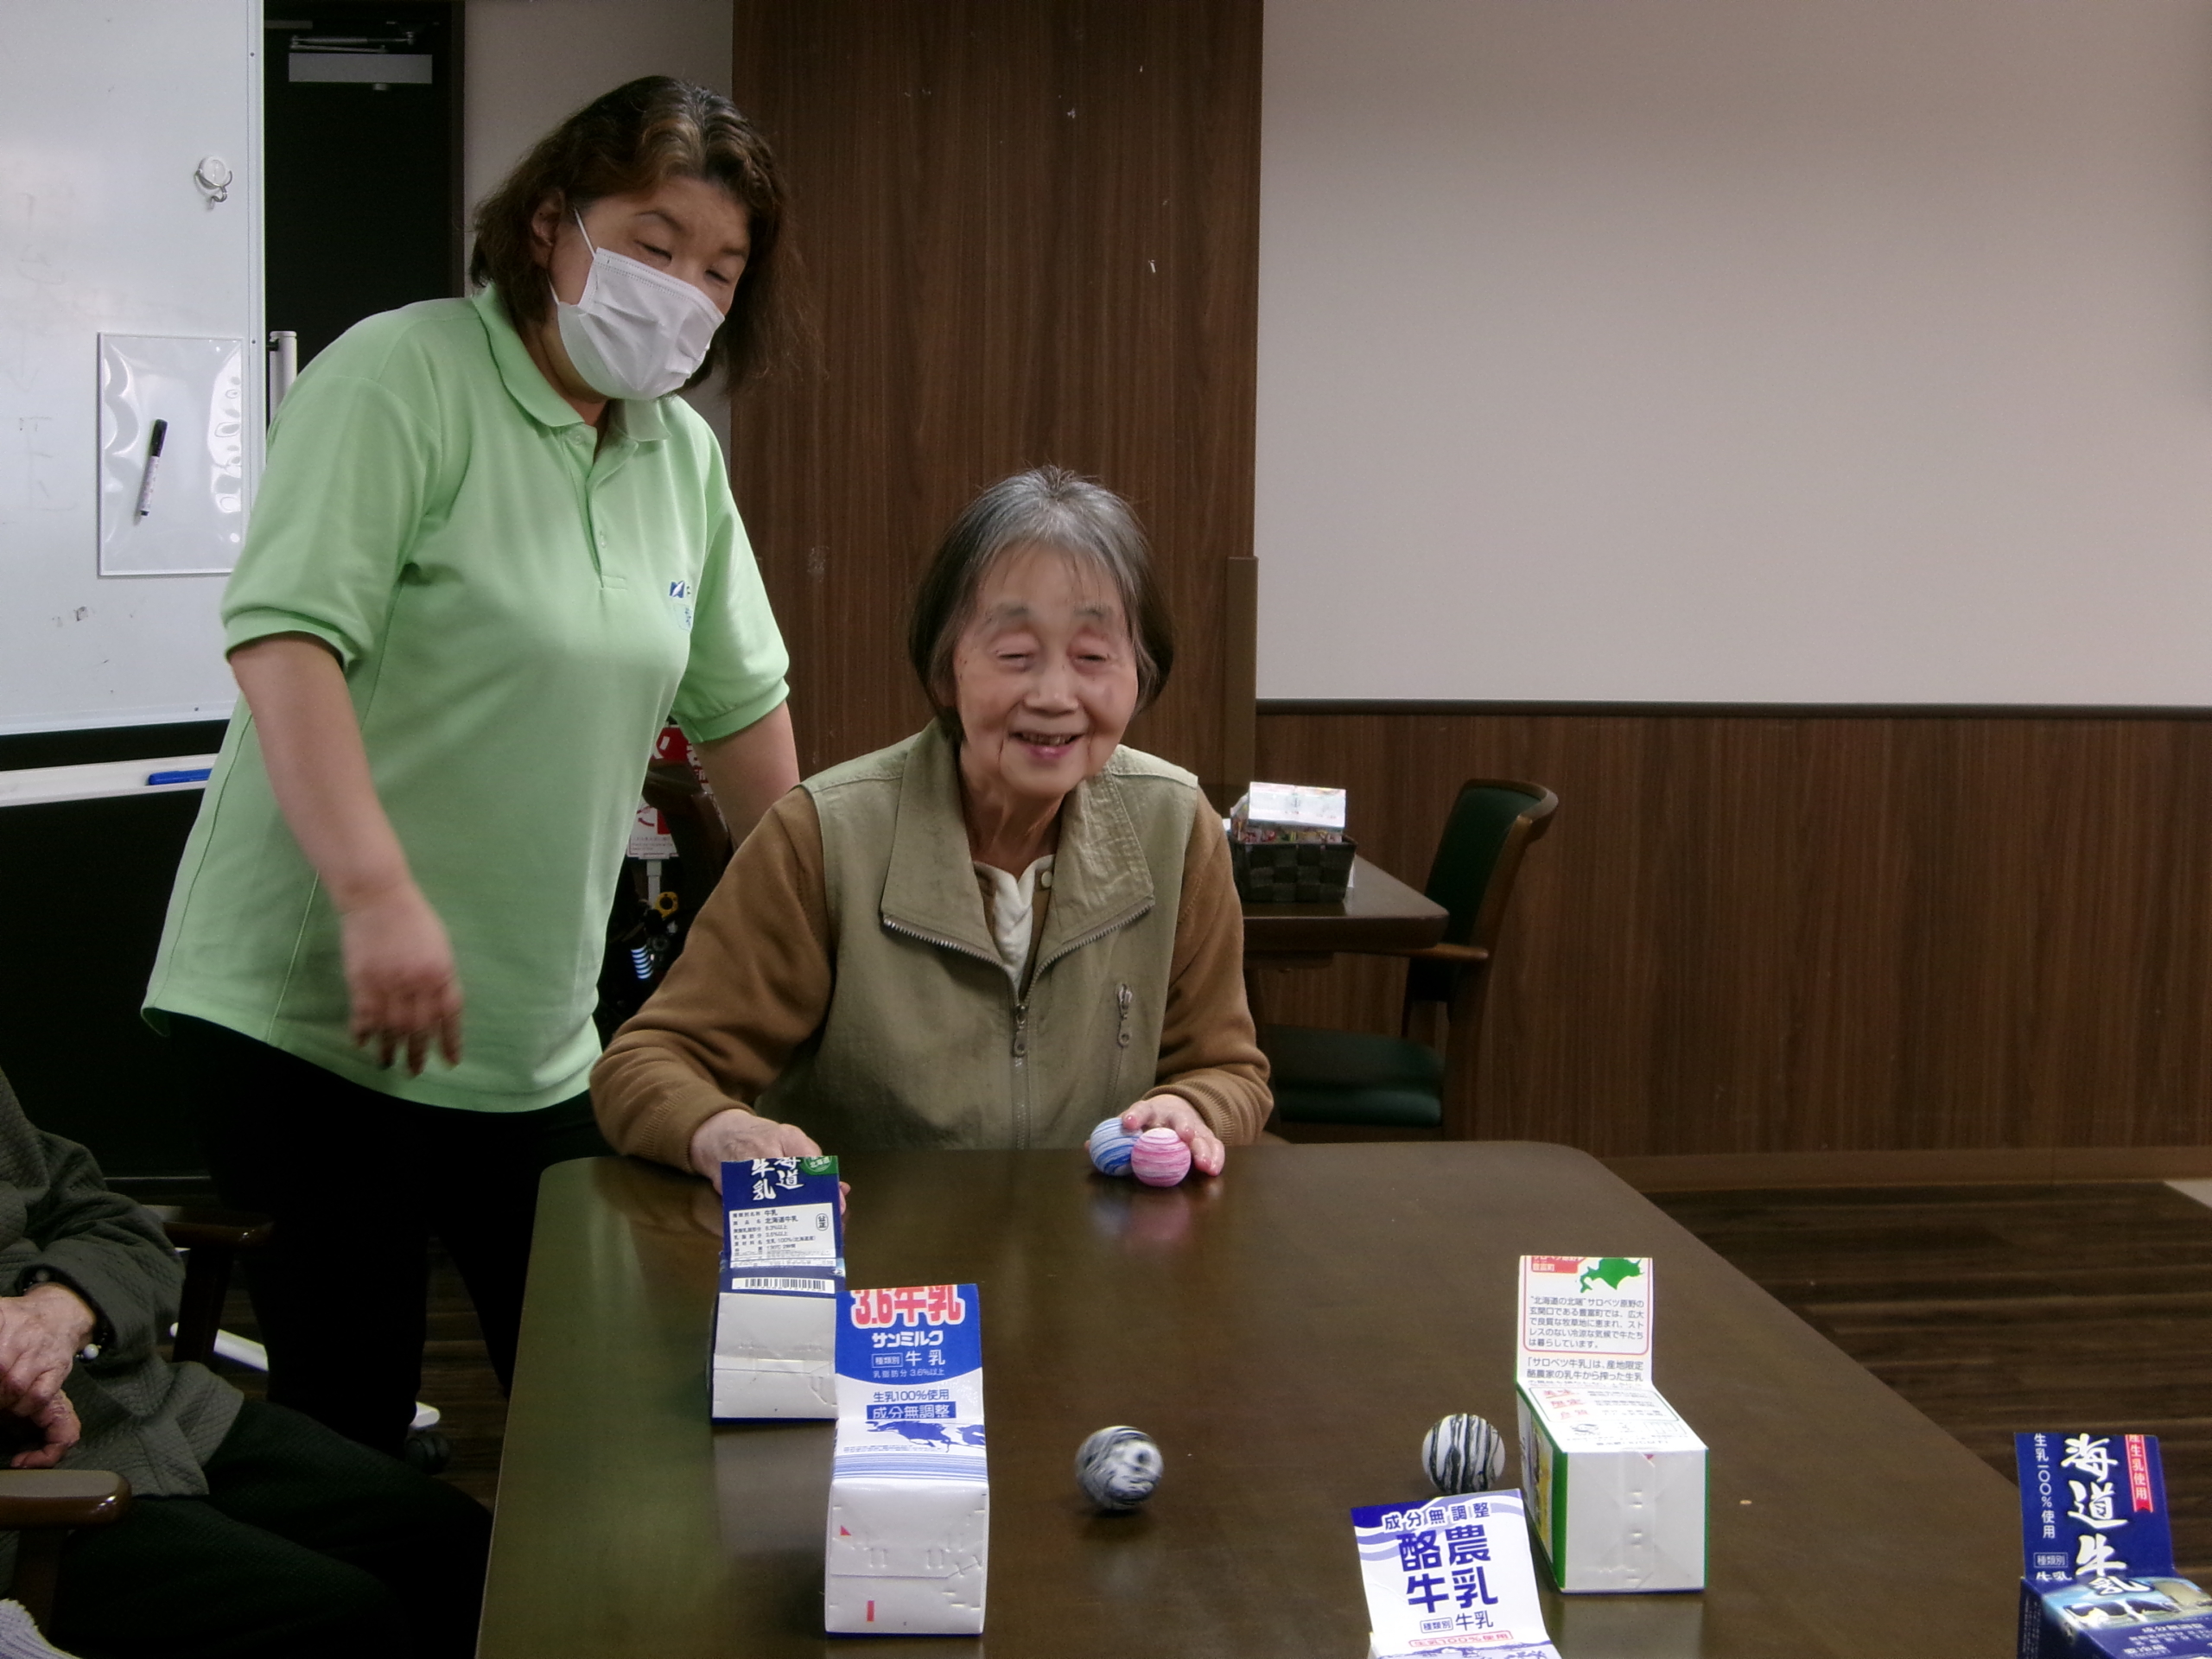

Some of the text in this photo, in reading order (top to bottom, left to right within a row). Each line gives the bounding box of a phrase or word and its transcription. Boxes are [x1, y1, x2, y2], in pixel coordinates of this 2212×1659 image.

[817, 1215, 827, 1228] 公正
[852, 1284, 964, 1327] 3.6牛乳
[872, 1331, 944, 1348] サンミルク
[1529, 1338, 1599, 1348] は暮らしています。
[875, 1350, 945, 1366] 種類別 牛乳
[1528, 1357, 1644, 1370] 「サロベツ牛乳」は、産地限定
[873, 1389, 950, 1402] 生乳100%使用
[872, 1404, 950, 1419] 成分無調整
[1384, 1503, 1491, 1530] 成分無調整
[1396, 1524, 1491, 1572] 酪農
[2037, 1554, 2066, 1566] 種類別
[2036, 1571, 2073, 1582] 牛乳
[1406, 1566, 1498, 1613] 牛乳
[1423, 1611, 1494, 1631] 種類別 牛乳
